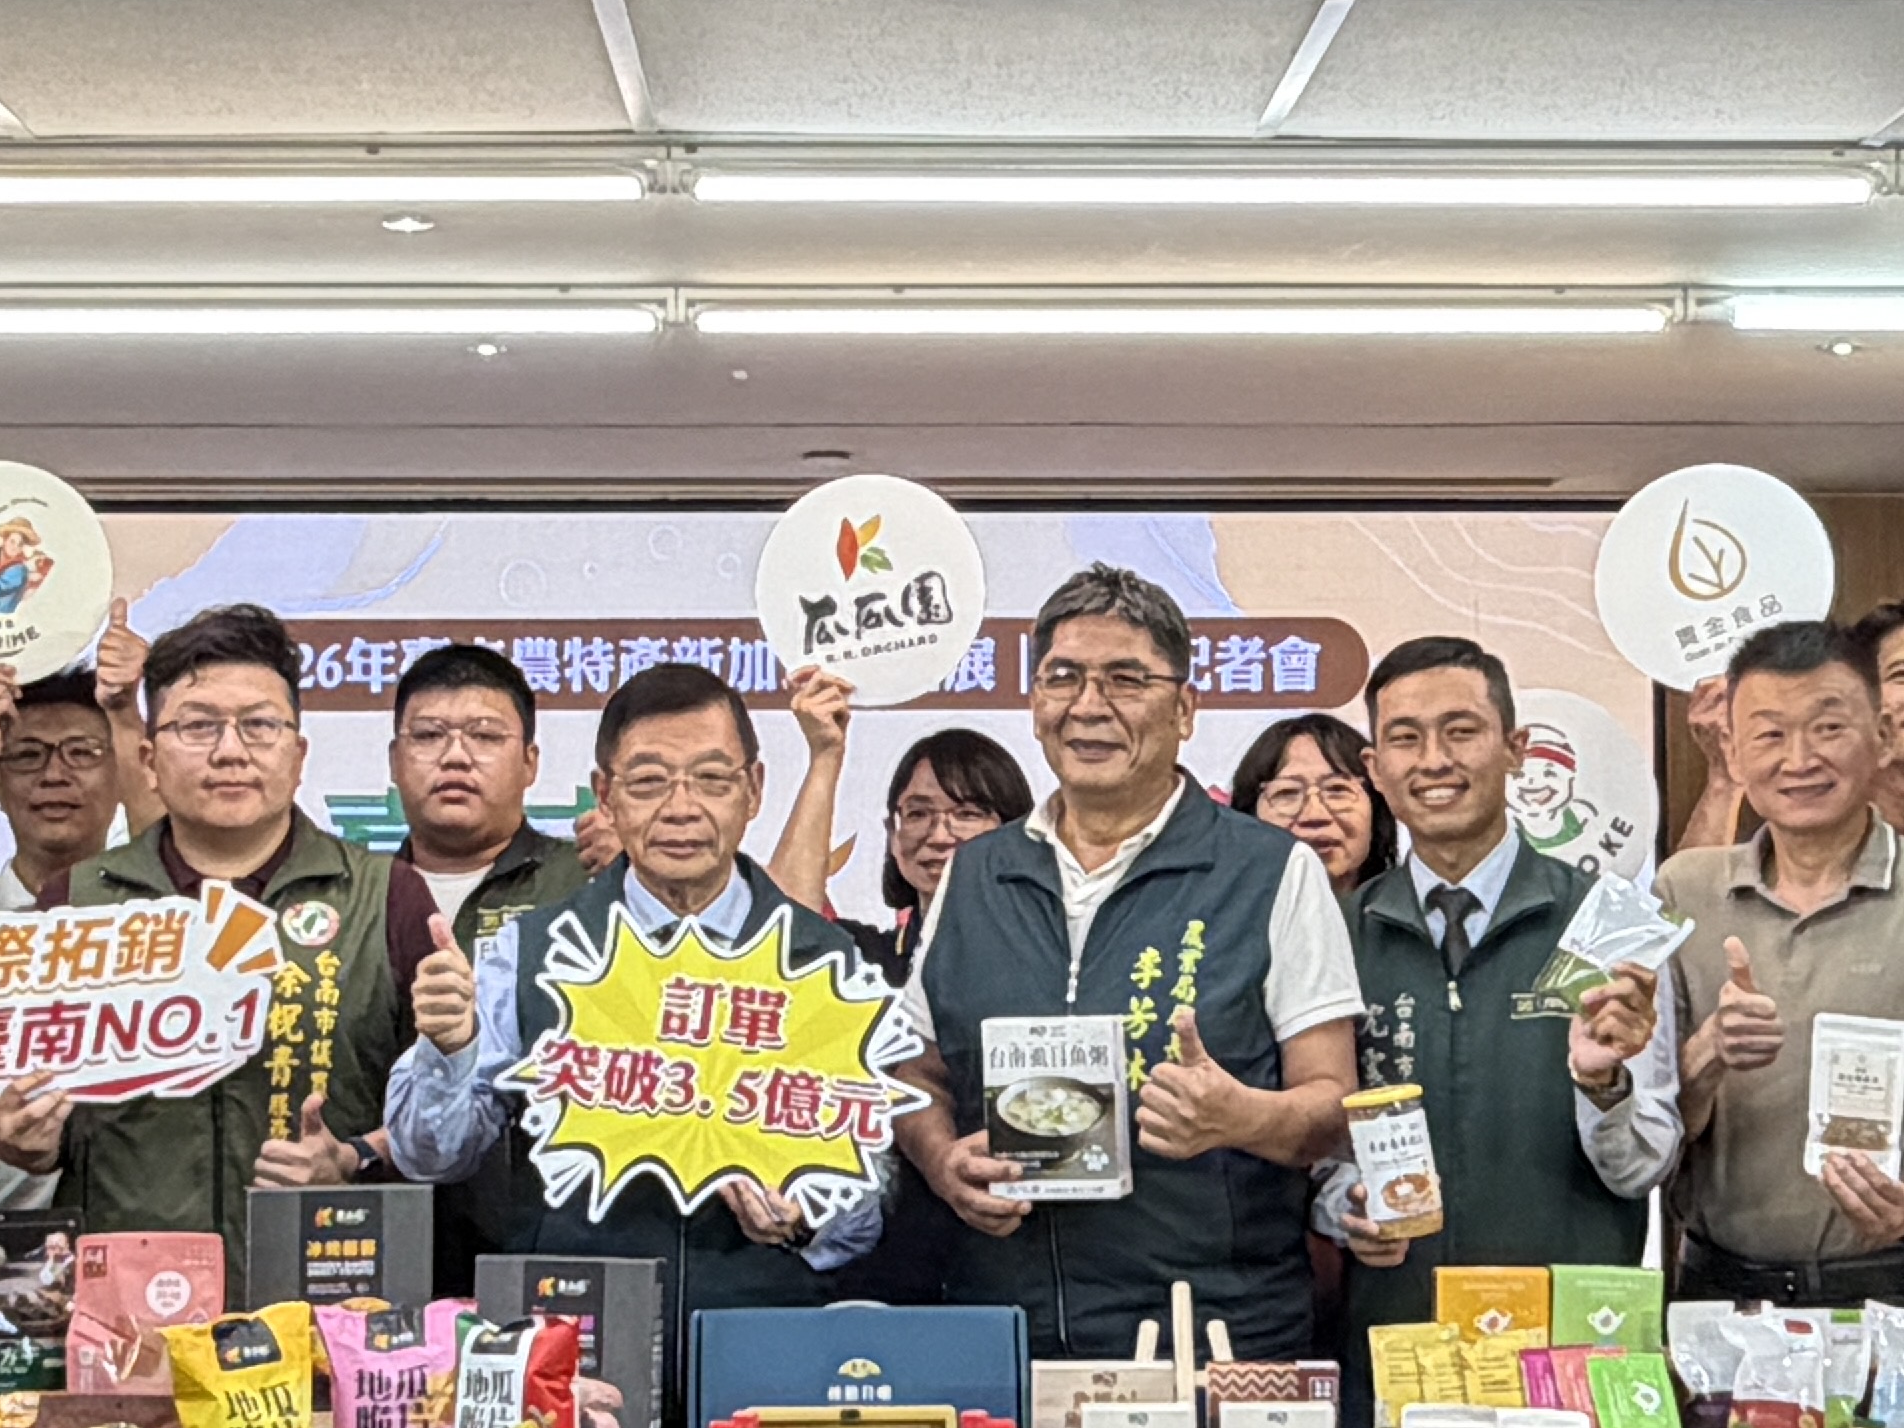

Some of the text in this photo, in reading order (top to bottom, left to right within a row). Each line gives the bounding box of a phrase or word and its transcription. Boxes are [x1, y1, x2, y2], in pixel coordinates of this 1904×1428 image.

[798, 571, 954, 656] 瓜瓜園
[659, 976, 790, 1049] 訂單
[536, 1038, 889, 1144] 突破3.5億元
[224, 1380, 300, 1422] 地瓜
[355, 1363, 434, 1402] 地瓜
[462, 1367, 516, 1406] 地瓜
